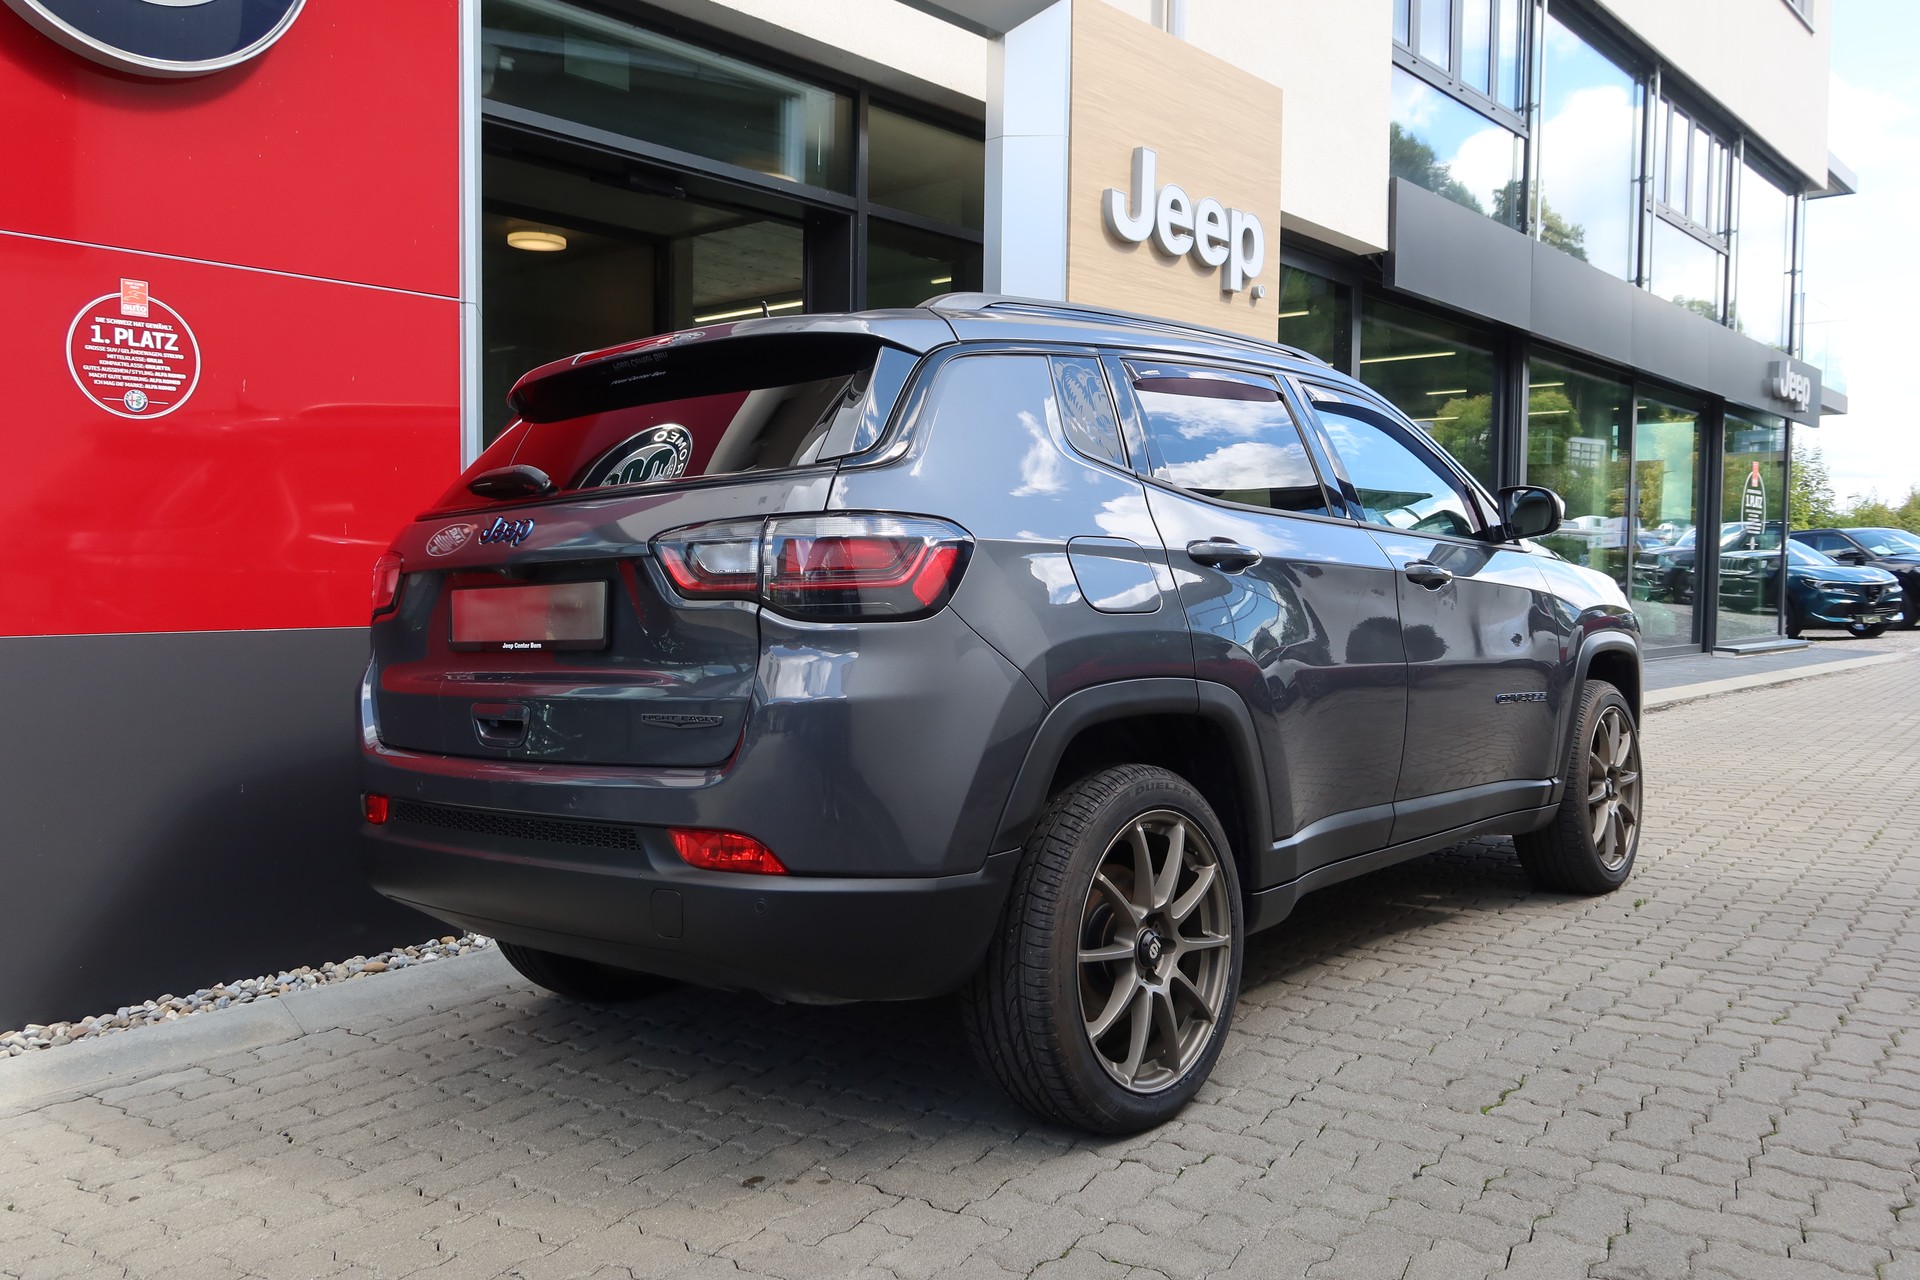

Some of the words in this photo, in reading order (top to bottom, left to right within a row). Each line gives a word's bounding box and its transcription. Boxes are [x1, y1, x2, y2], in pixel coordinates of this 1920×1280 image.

[1103, 146, 1265, 293] Jeep
[123, 304, 147, 313] auto
[106, 318, 133, 326] SCHWEIZ
[91, 325, 110, 344] 1.
[114, 327, 179, 351] PLATZ
[1773, 360, 1810, 412] Jeep
[479, 516, 535, 547] Jeep
[502, 642, 514, 650] Jeep
[1134, 782, 1192, 799] DUELER
